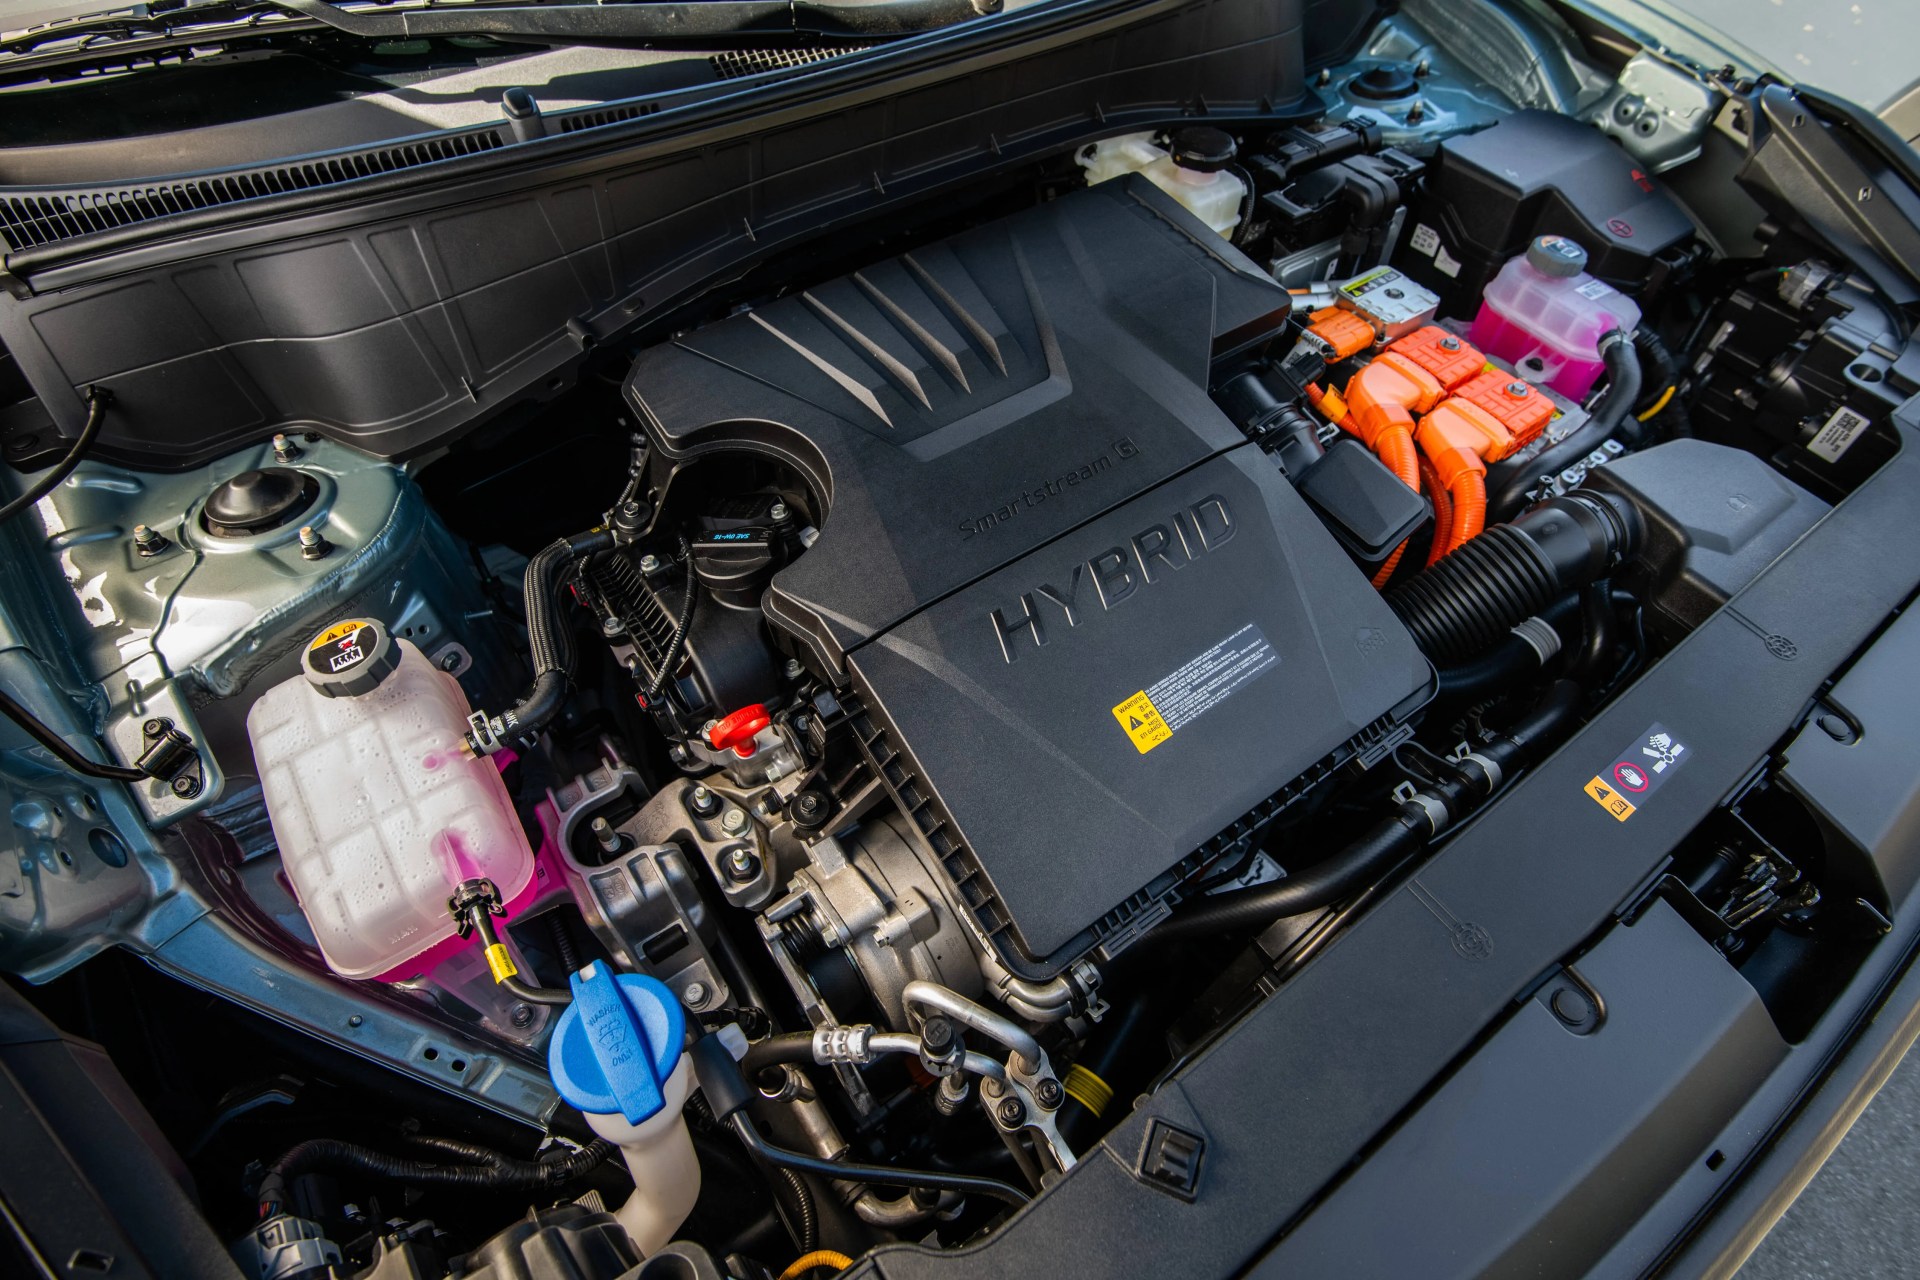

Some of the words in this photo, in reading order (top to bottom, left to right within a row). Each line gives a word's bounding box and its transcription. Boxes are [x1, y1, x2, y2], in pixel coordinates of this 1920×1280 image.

[958, 455, 1112, 542] Smartstream
[990, 493, 1238, 665] HYBRID
[1118, 695, 1145, 714] WARNING
[587, 1004, 621, 1028] WASHER
[612, 1048, 633, 1067] ONLY
